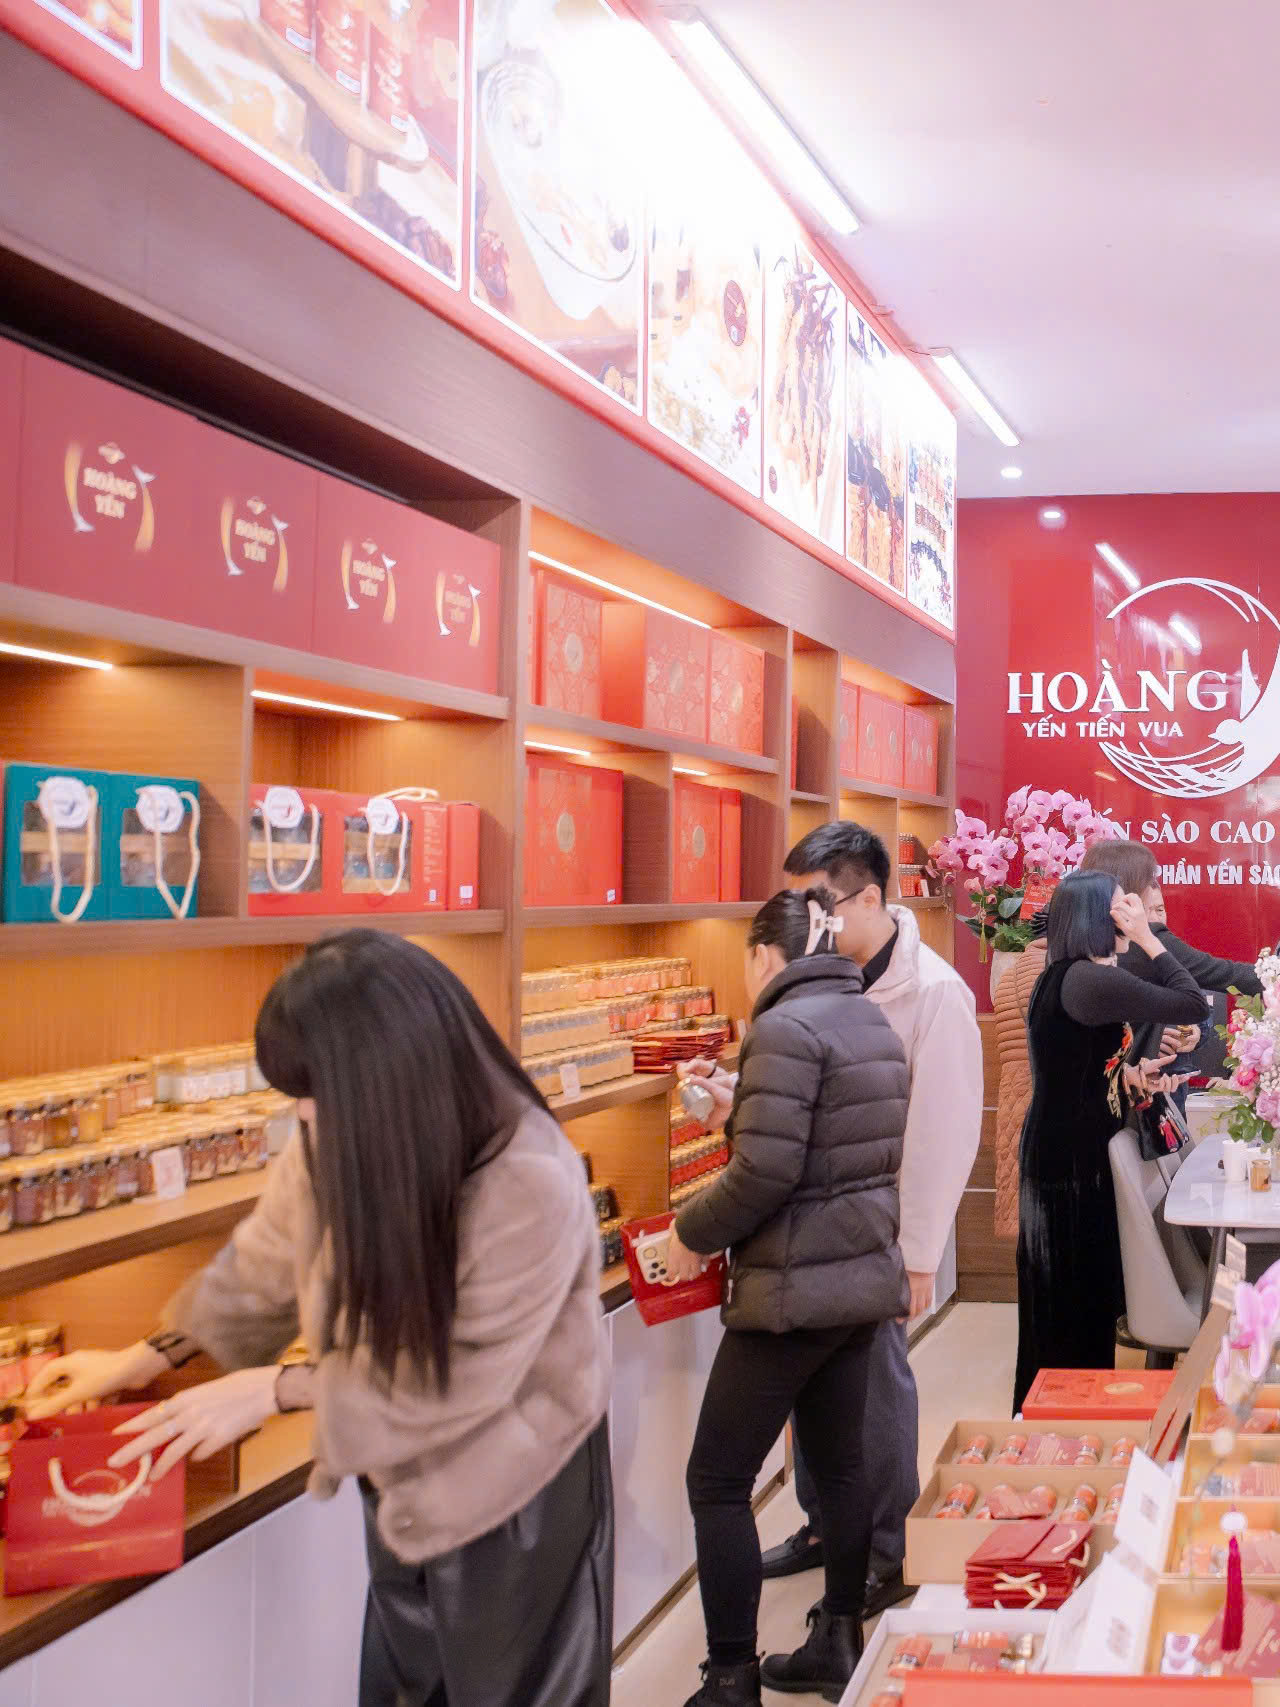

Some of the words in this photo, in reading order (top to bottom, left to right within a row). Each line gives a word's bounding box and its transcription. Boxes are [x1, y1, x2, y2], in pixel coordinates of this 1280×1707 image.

[1006, 658, 1229, 714] HOÀNG
[1022, 714, 1066, 738] YẾN
[1138, 721, 1184, 738] VUA
[1141, 812, 1200, 844] SÀO
[1210, 820, 1276, 844] CAO
[1207, 857, 1243, 885] YẾN
